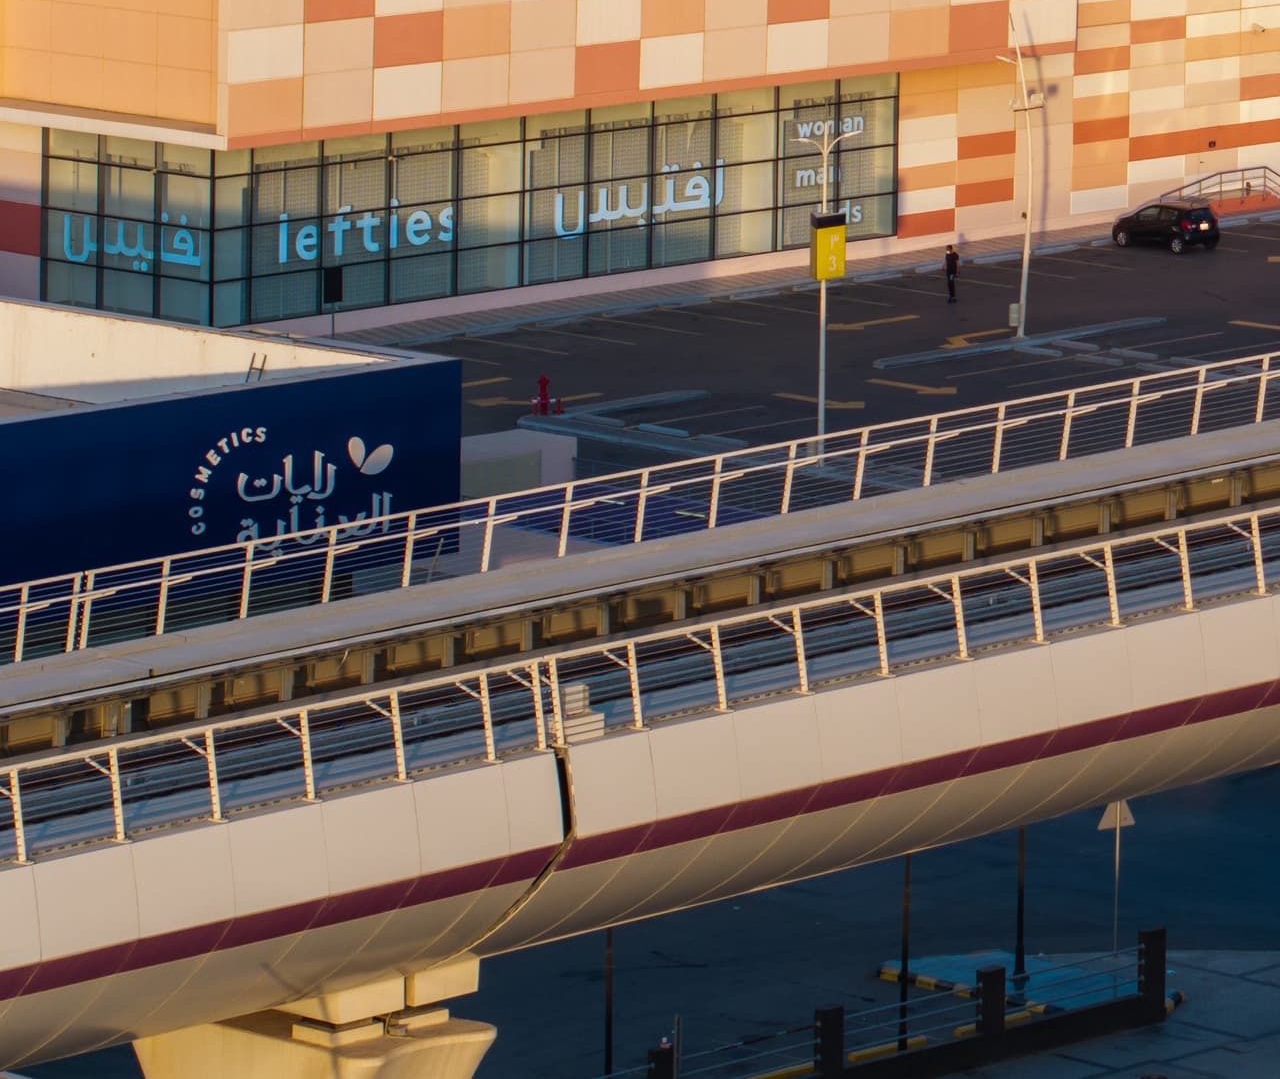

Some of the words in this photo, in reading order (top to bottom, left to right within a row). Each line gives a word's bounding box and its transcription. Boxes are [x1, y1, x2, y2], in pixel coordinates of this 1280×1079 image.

[278, 197, 453, 264] lefties
[828, 255, 837, 272] 3
[188, 426, 267, 536] COSMETICS
[236, 450, 337, 504] رايات
